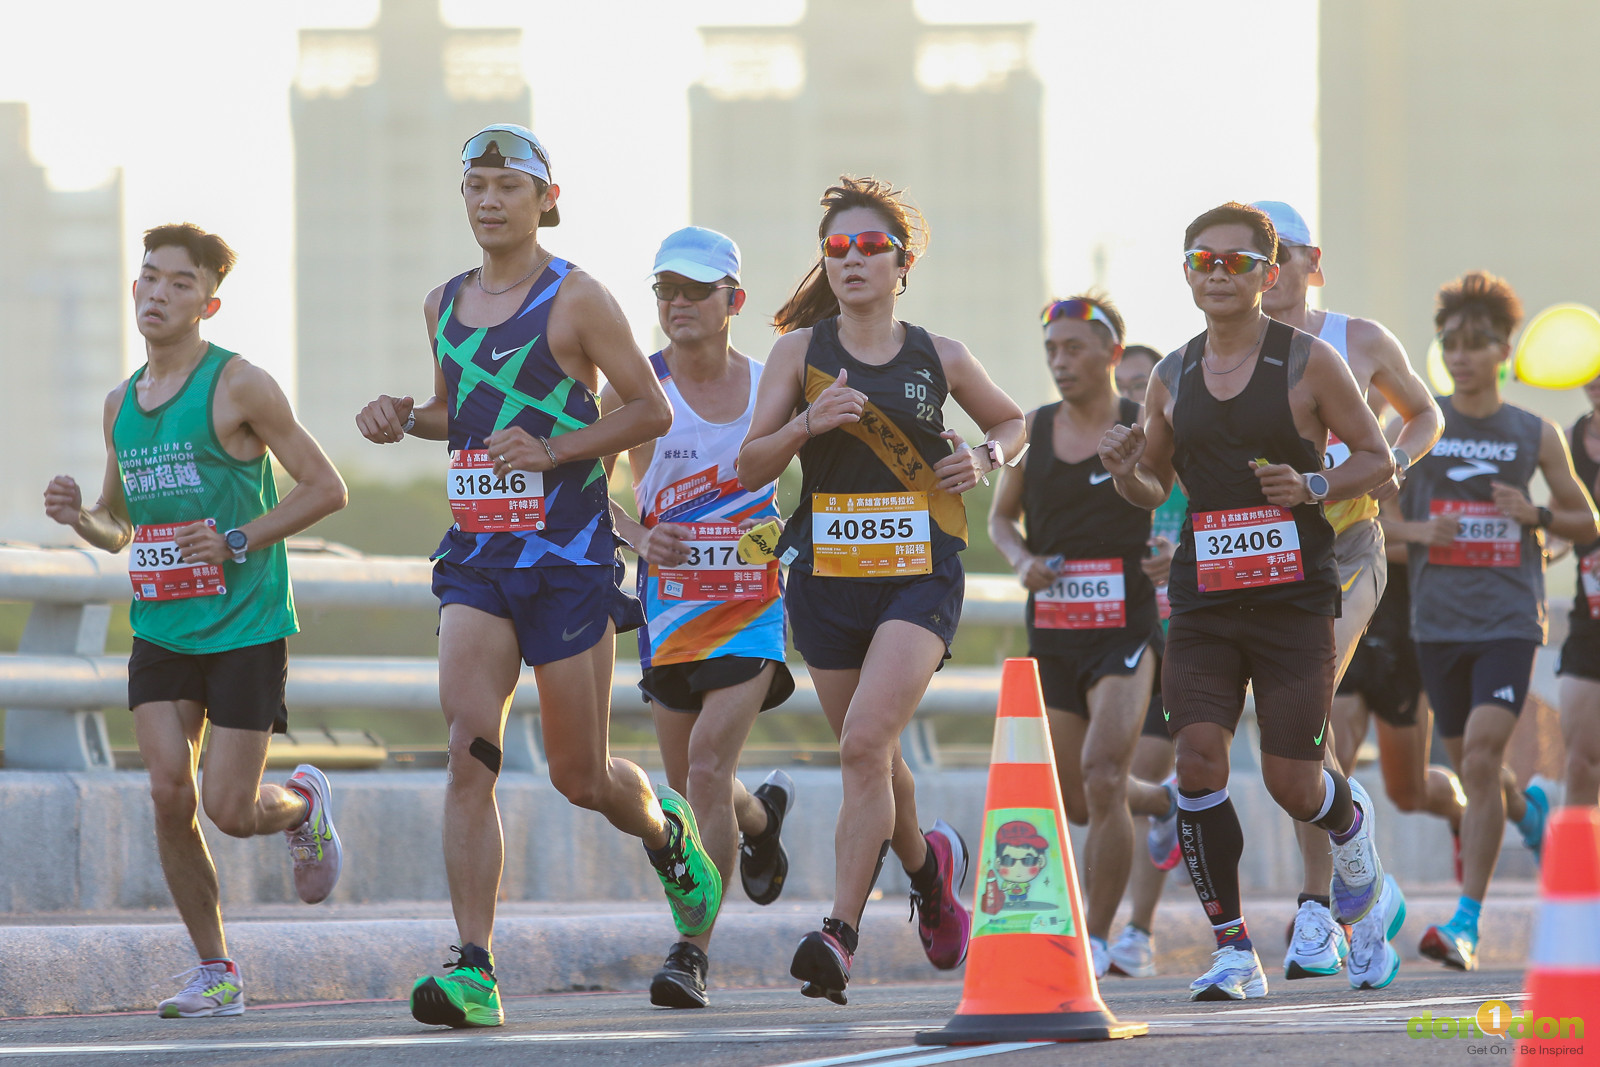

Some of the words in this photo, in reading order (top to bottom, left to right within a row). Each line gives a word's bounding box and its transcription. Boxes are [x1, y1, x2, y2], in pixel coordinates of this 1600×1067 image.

[916, 402, 935, 421] 22
[1431, 437, 1518, 462] BROOKS
[121, 458, 141, 469] UBON
[144, 452, 195, 466] MARATHON
[124, 461, 202, 497] 向前超越
[455, 473, 526, 495] 31846
[676, 475, 707, 493] amino
[676, 482, 712, 502] STRONG
[856, 495, 915, 507] 高雄富邦馬拉松
[827, 517, 914, 540] 40855
[1457, 522, 1508, 539] 2682
[1207, 528, 1283, 556] 32406
[136, 547, 185, 568] 3352
[678, 546, 749, 567] 317
